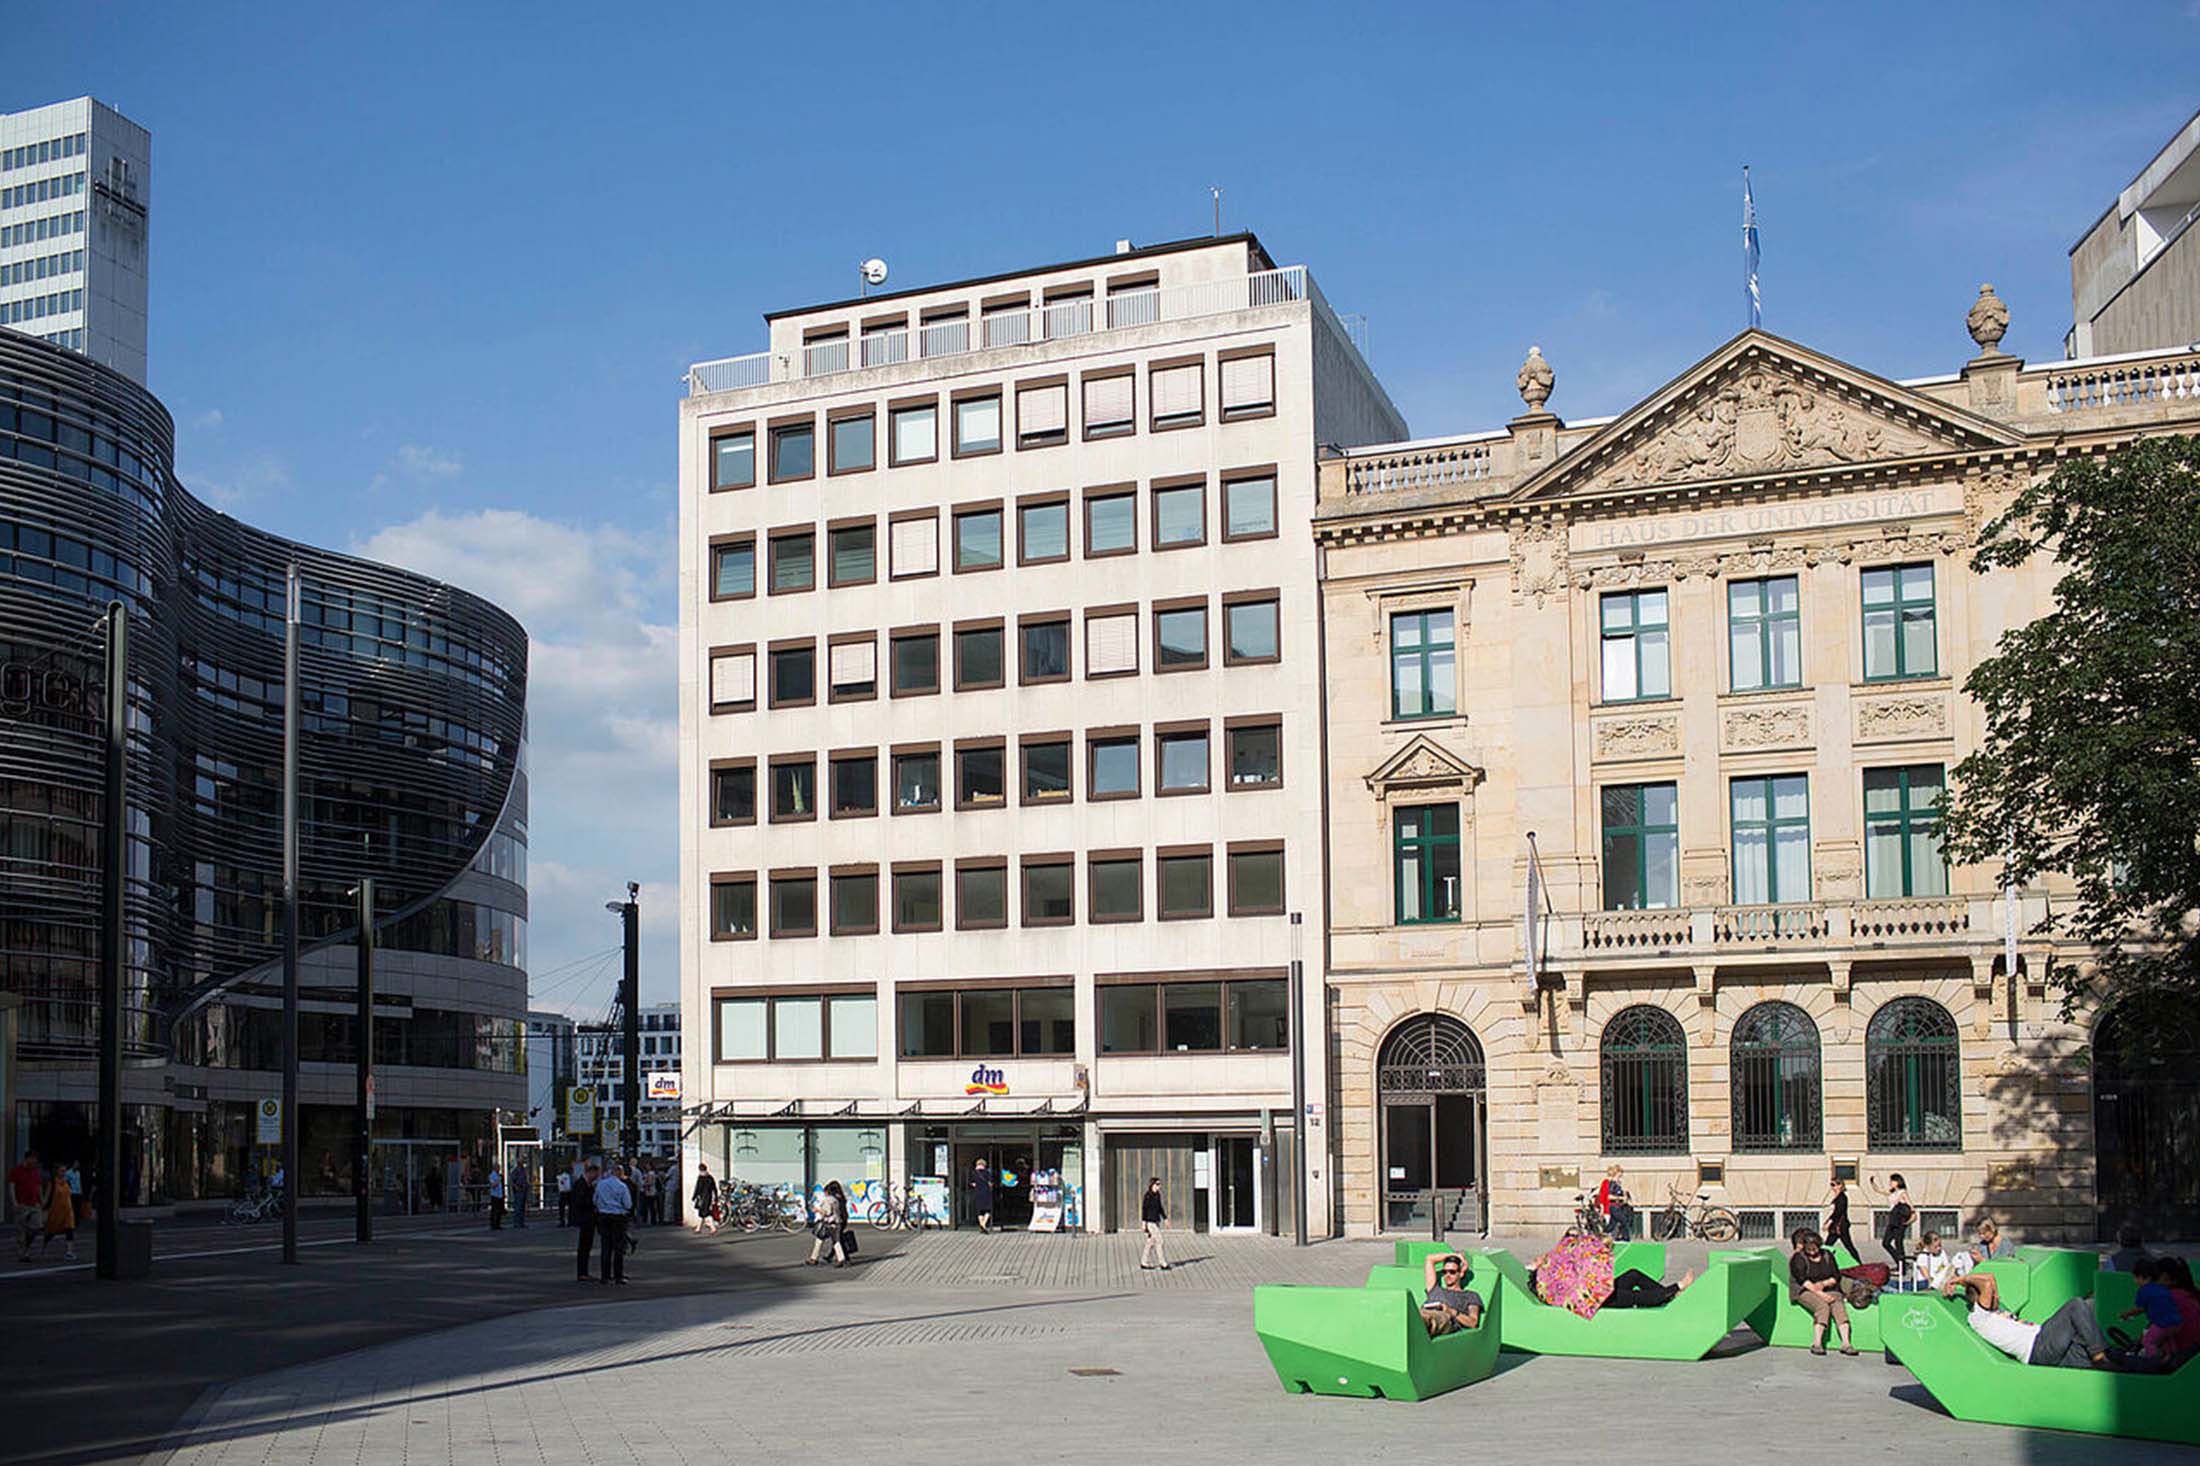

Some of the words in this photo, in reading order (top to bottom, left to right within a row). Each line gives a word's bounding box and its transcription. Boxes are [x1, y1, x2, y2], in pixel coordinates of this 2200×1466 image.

[1597, 521, 1672, 545] HAUS
[1680, 513, 1738, 537] DER
[1746, 492, 1933, 530] UNIVERSITÄT
[971, 1064, 1003, 1085] dm
[655, 1077, 675, 1089] dm
[1310, 1118, 1320, 1127] 12
